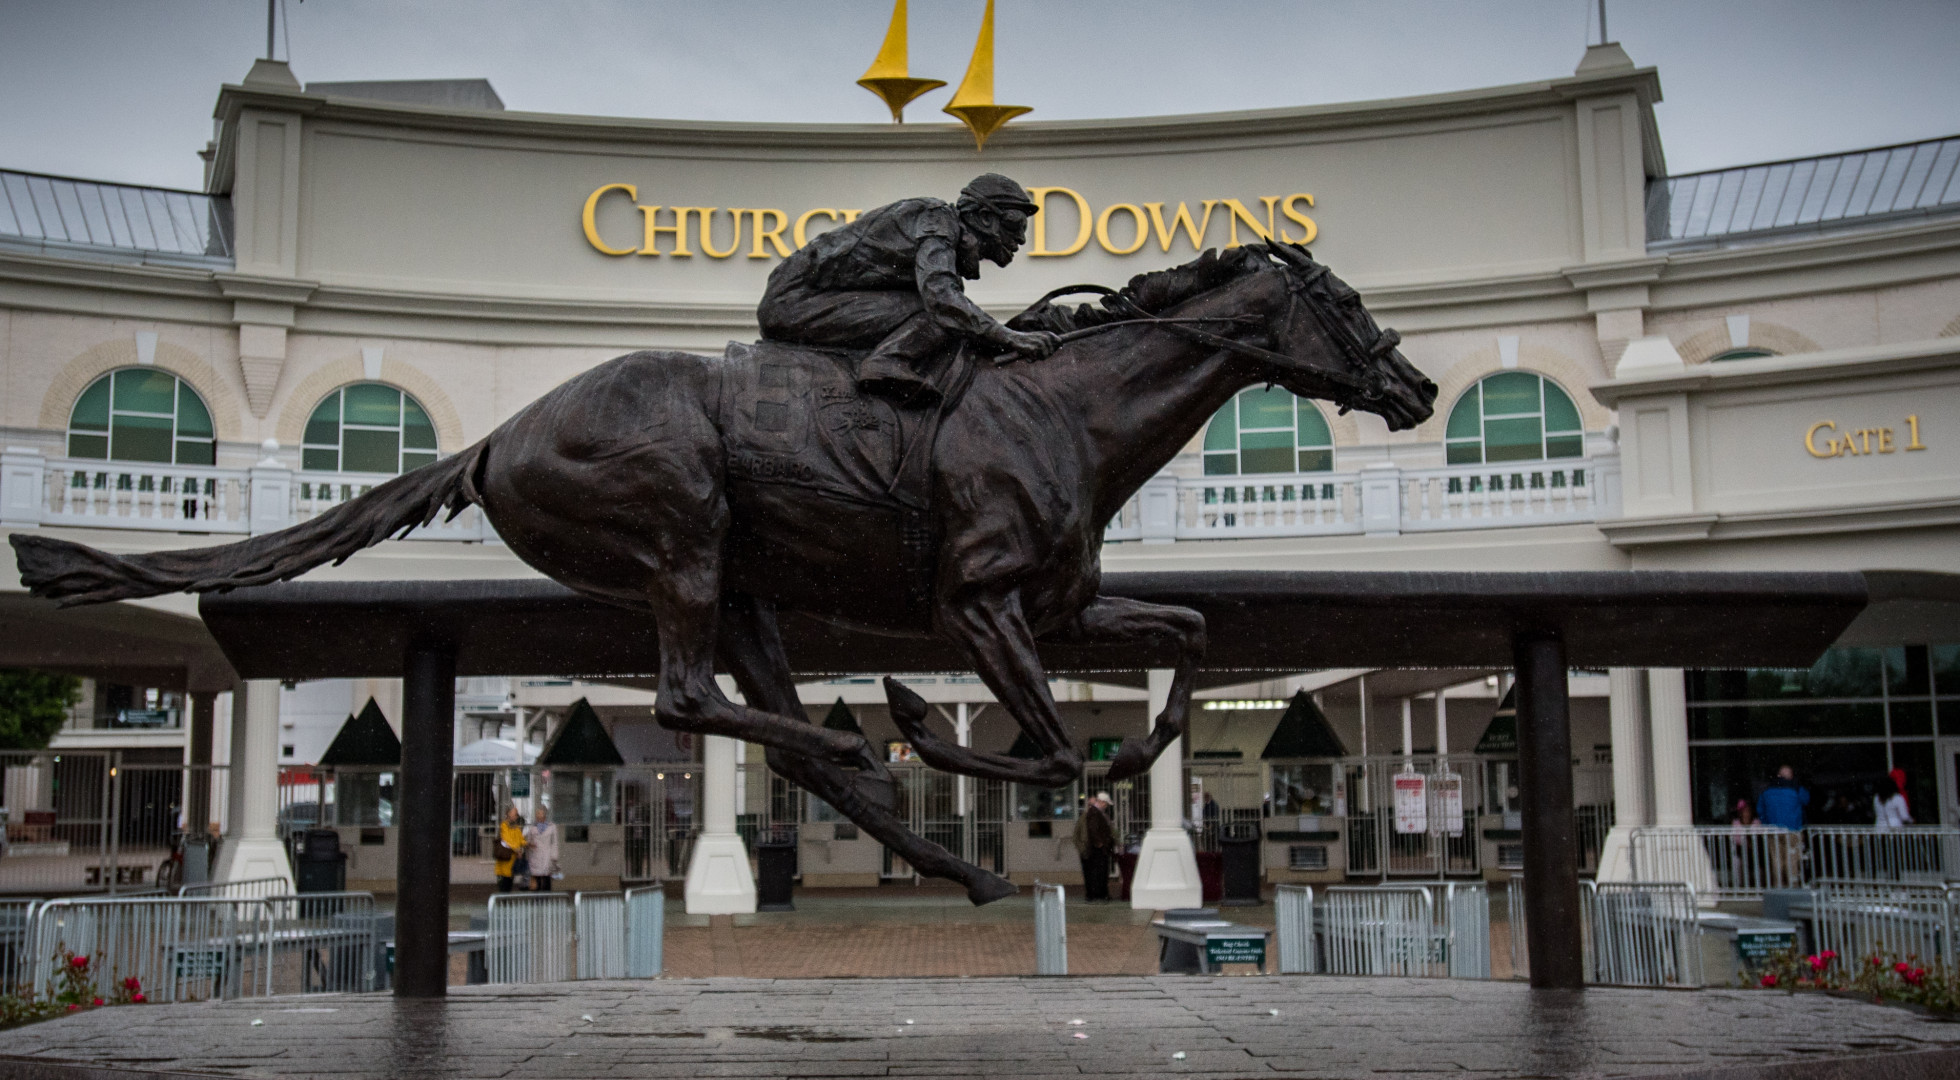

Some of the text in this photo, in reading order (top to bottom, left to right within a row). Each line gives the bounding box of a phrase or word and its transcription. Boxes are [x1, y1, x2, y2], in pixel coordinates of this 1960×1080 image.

[582, 183, 1319, 260] CHURC DOWNS
[1804, 414, 1927, 459] GATE 1
